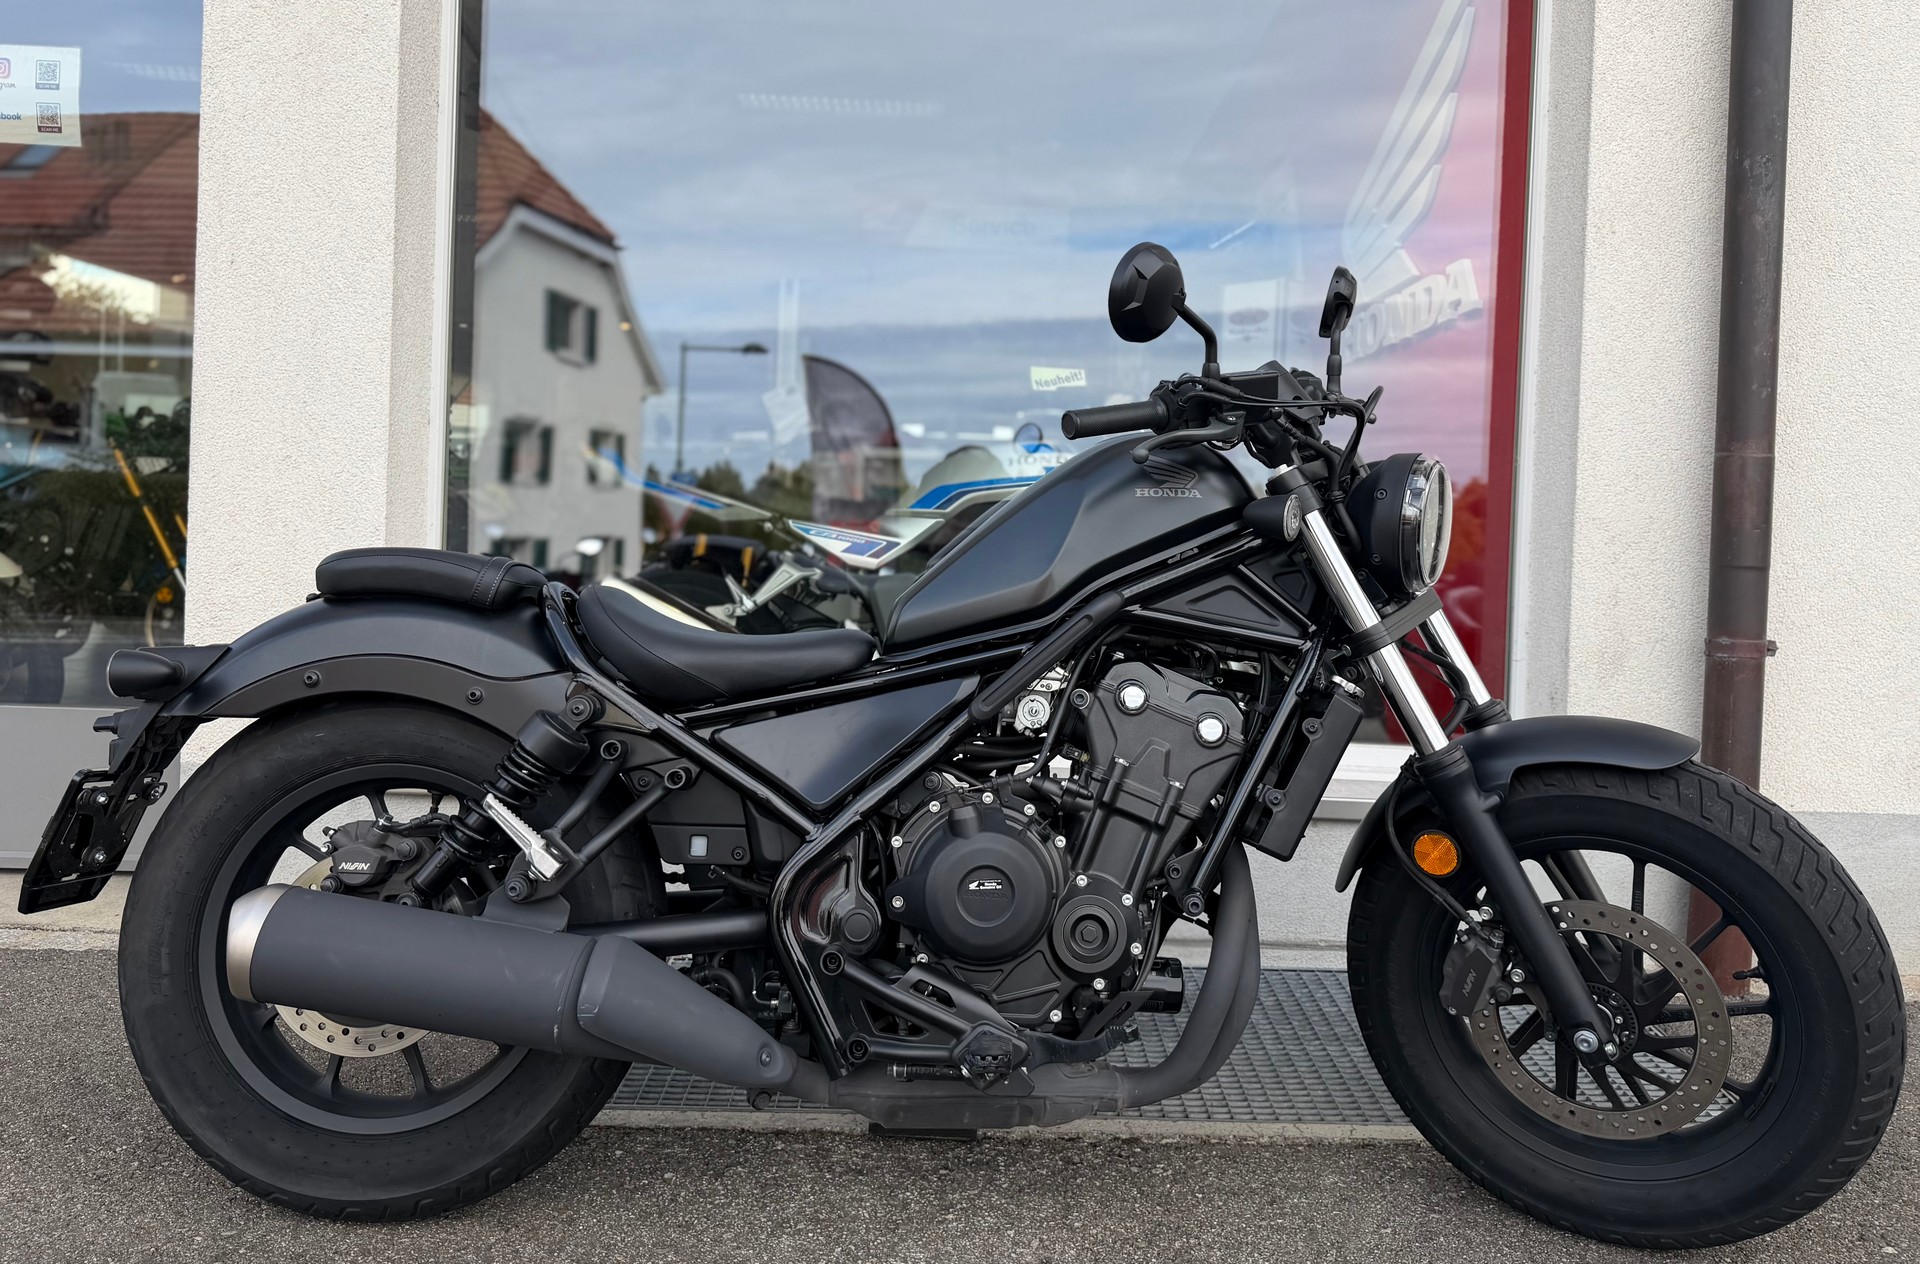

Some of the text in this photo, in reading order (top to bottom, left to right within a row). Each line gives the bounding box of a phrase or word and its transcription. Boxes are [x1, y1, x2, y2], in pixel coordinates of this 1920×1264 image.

[1034, 370, 1084, 388] Neuheit!
[1008, 453, 1069, 466] HOND
[1134, 488, 1204, 499] HONDA
